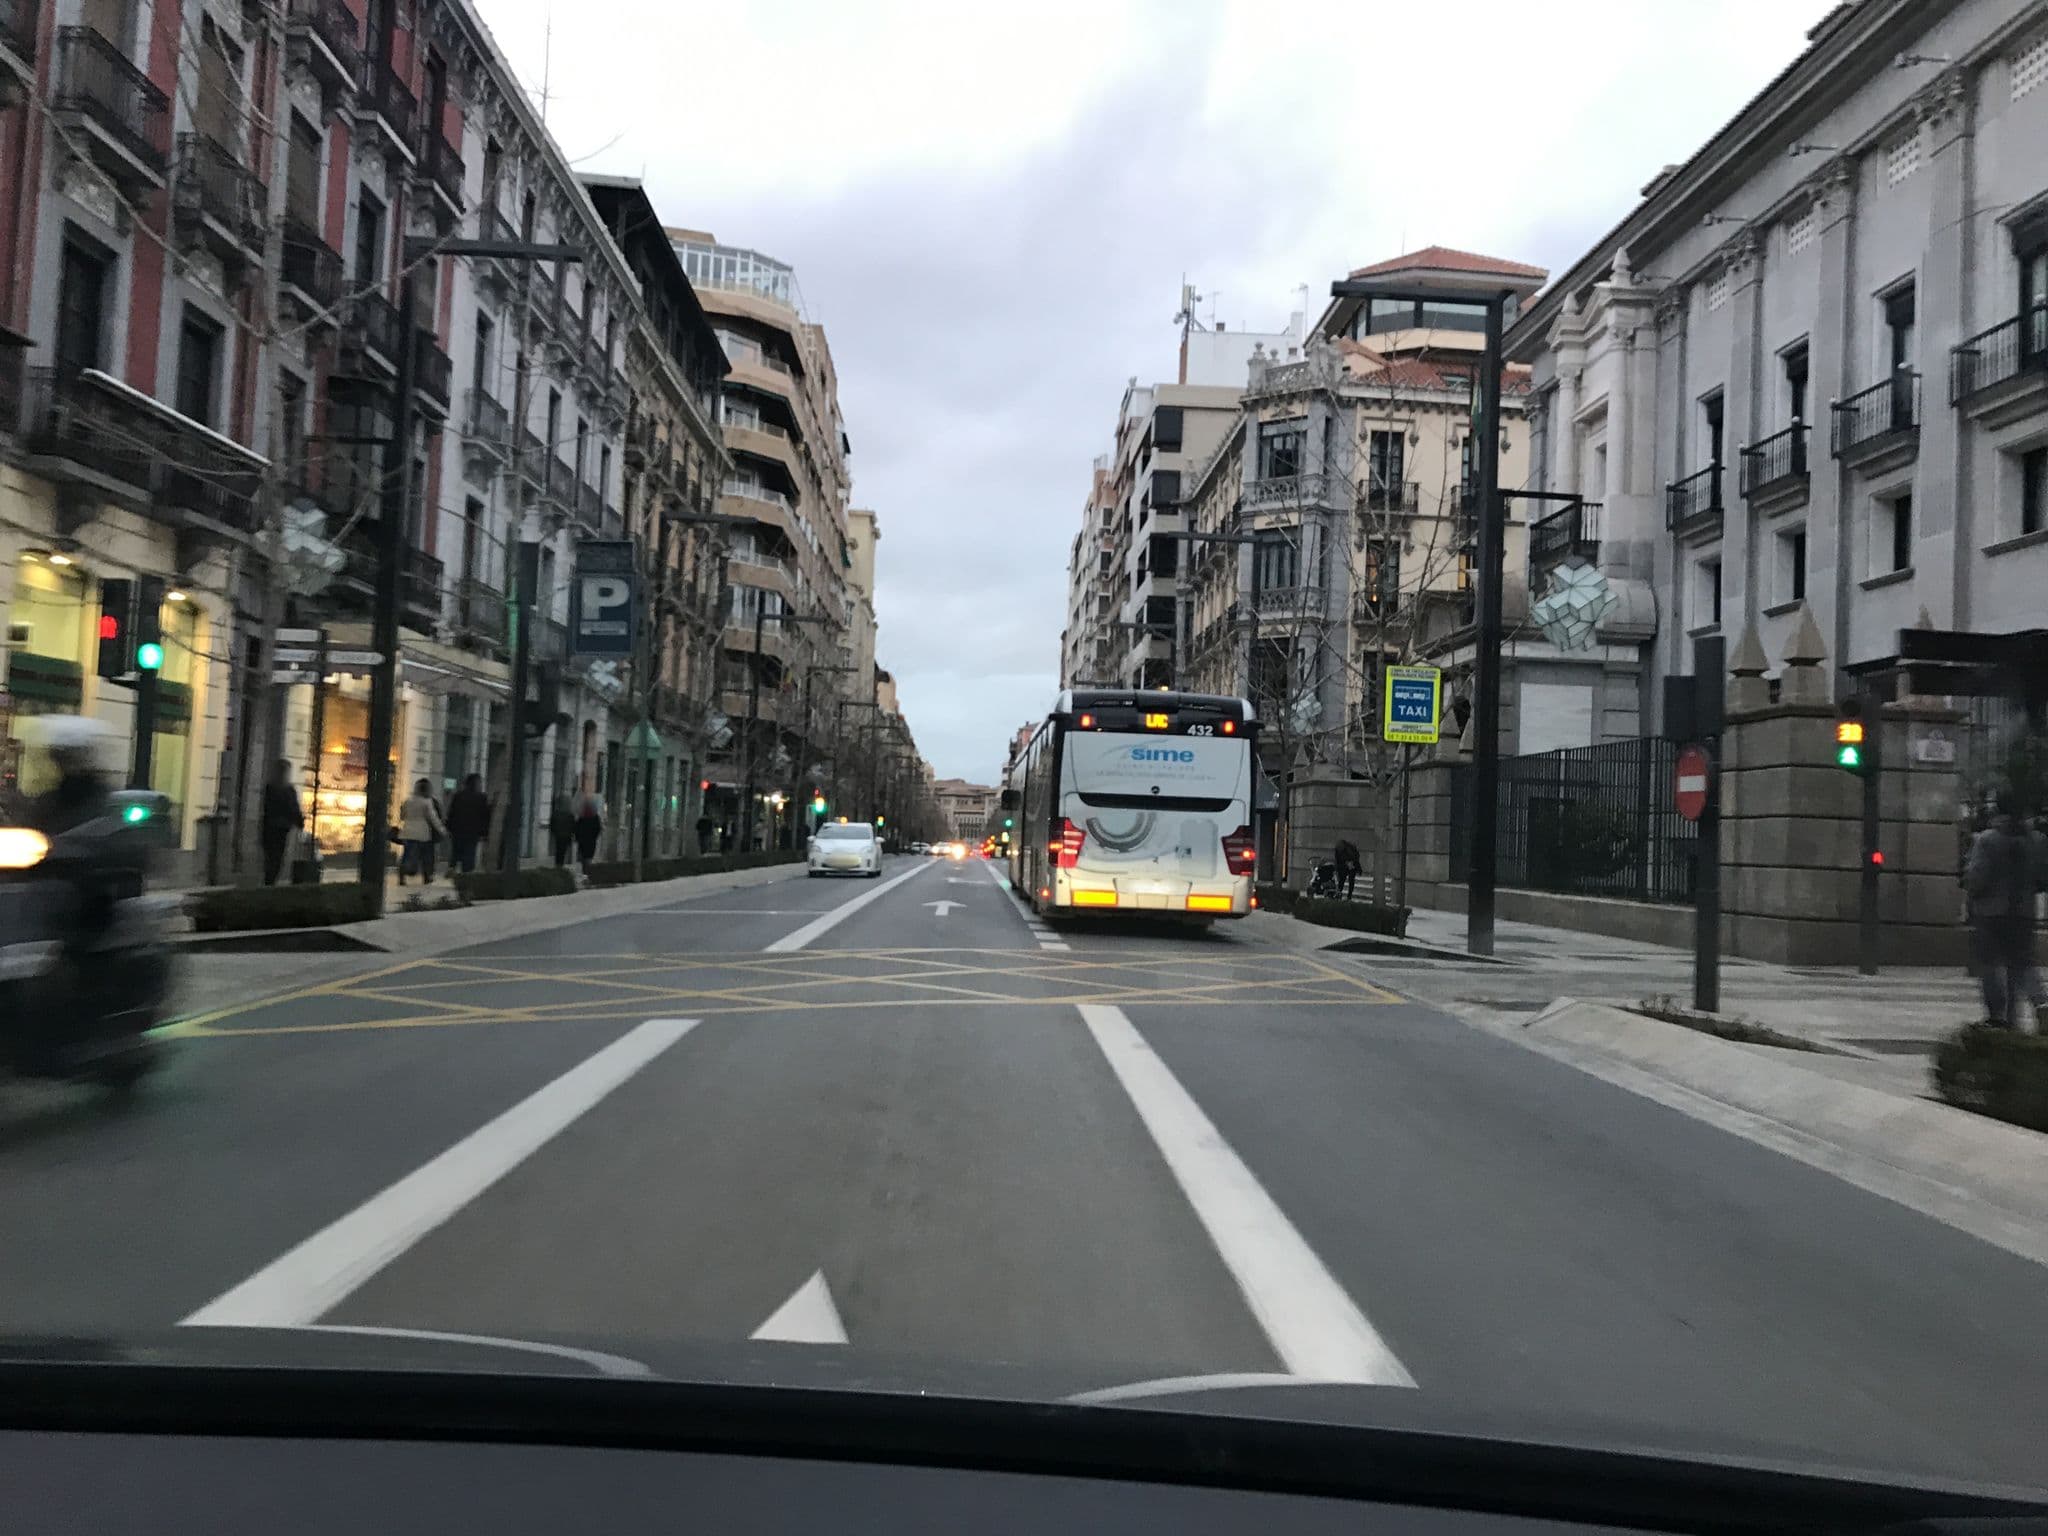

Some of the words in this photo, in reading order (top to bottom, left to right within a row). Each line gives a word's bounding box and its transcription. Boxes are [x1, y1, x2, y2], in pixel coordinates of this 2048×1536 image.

[582, 577, 629, 620] P
[1398, 705, 1427, 717] TAXI
[1187, 724, 1214, 736] 432
[1131, 748, 1194, 762] sime
